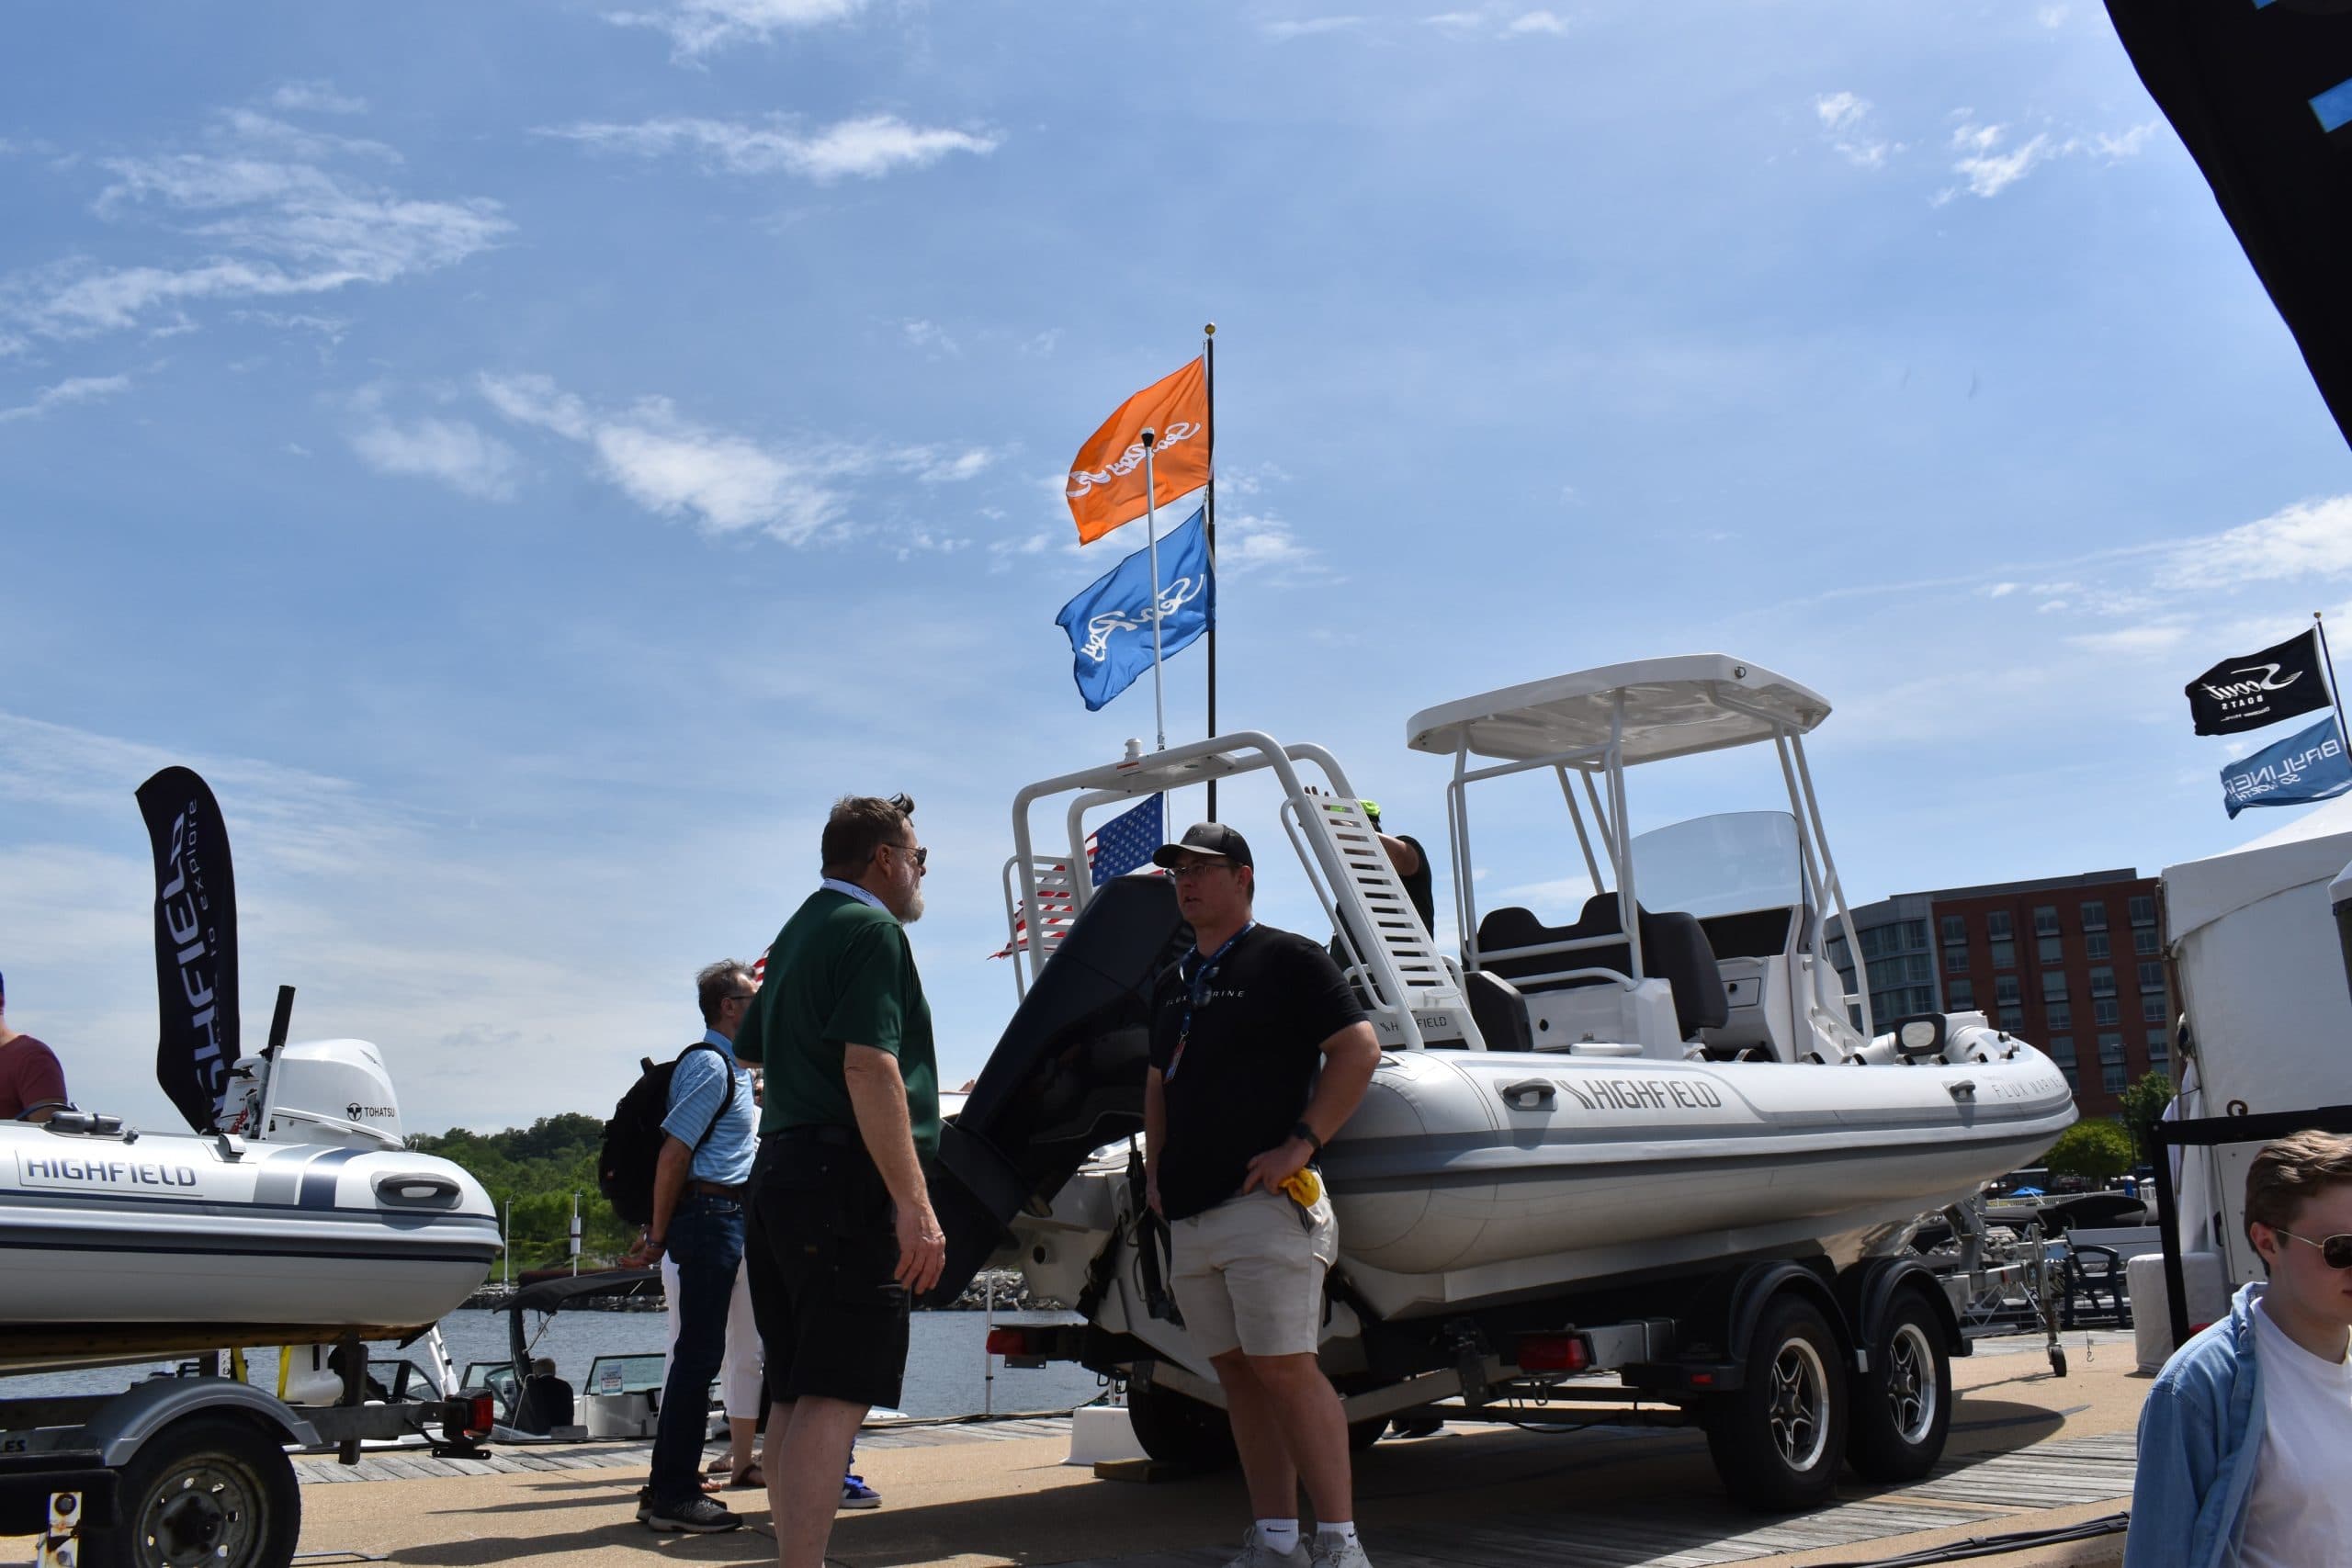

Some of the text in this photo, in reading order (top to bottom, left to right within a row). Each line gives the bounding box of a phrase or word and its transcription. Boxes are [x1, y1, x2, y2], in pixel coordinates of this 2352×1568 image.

[187, 797, 209, 910] explore
[1212, 990, 1245, 998] RINE
[1390, 1016, 1447, 1032] HFIELD
[1582, 1079, 1722, 1110] HIGHFIELD
[1991, 1082, 2029, 1099] FLUX
[364, 1107, 395, 1118] TOHATSU
[27, 1156, 198, 1187] HIGHFIELD
